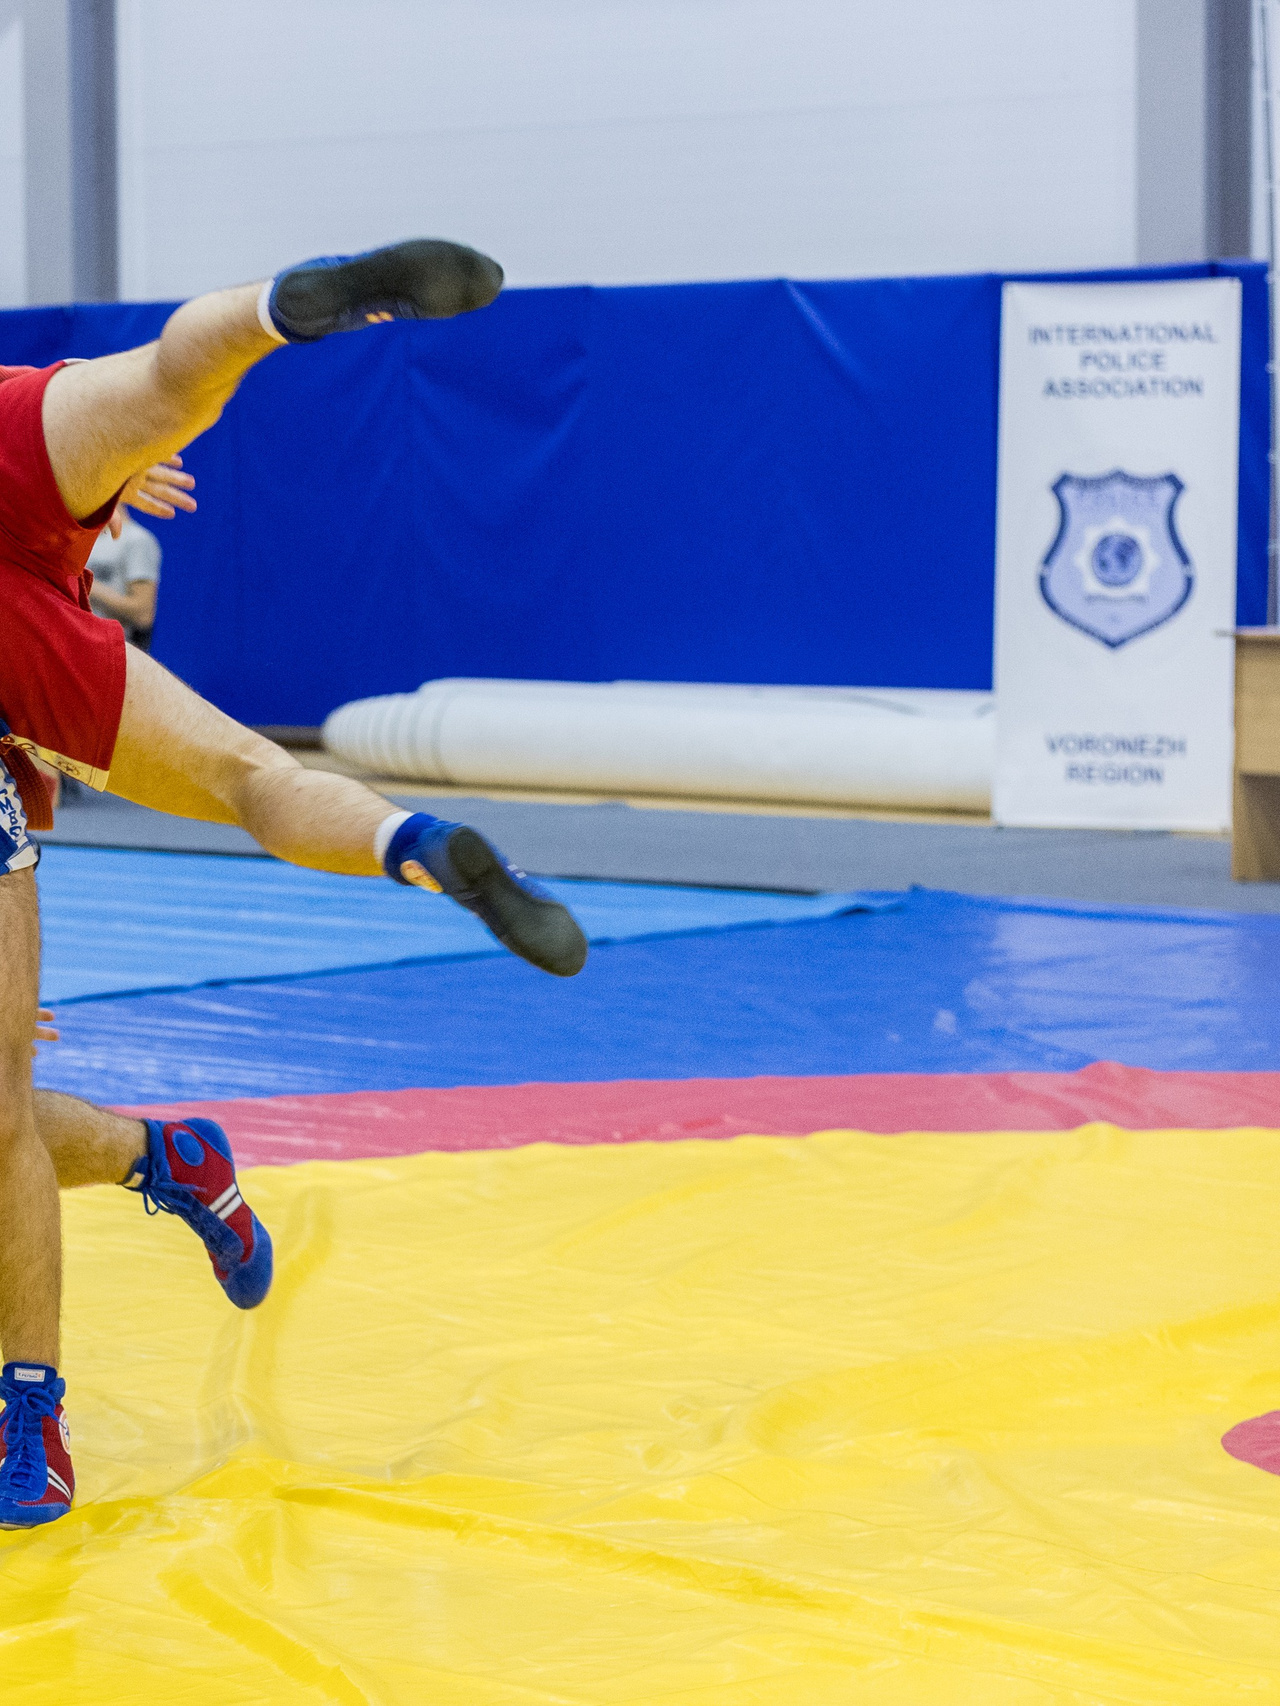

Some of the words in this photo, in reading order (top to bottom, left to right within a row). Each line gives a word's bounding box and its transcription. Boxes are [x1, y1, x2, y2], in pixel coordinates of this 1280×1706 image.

[1028, 322, 1217, 345] INTERNATIONAL
[1079, 350, 1167, 372] POLICE
[1042, 376, 1205, 398] ASSOCIATION
[1046, 733, 1187, 757] VORONEZH
[1065, 762, 1164, 785] REGION
